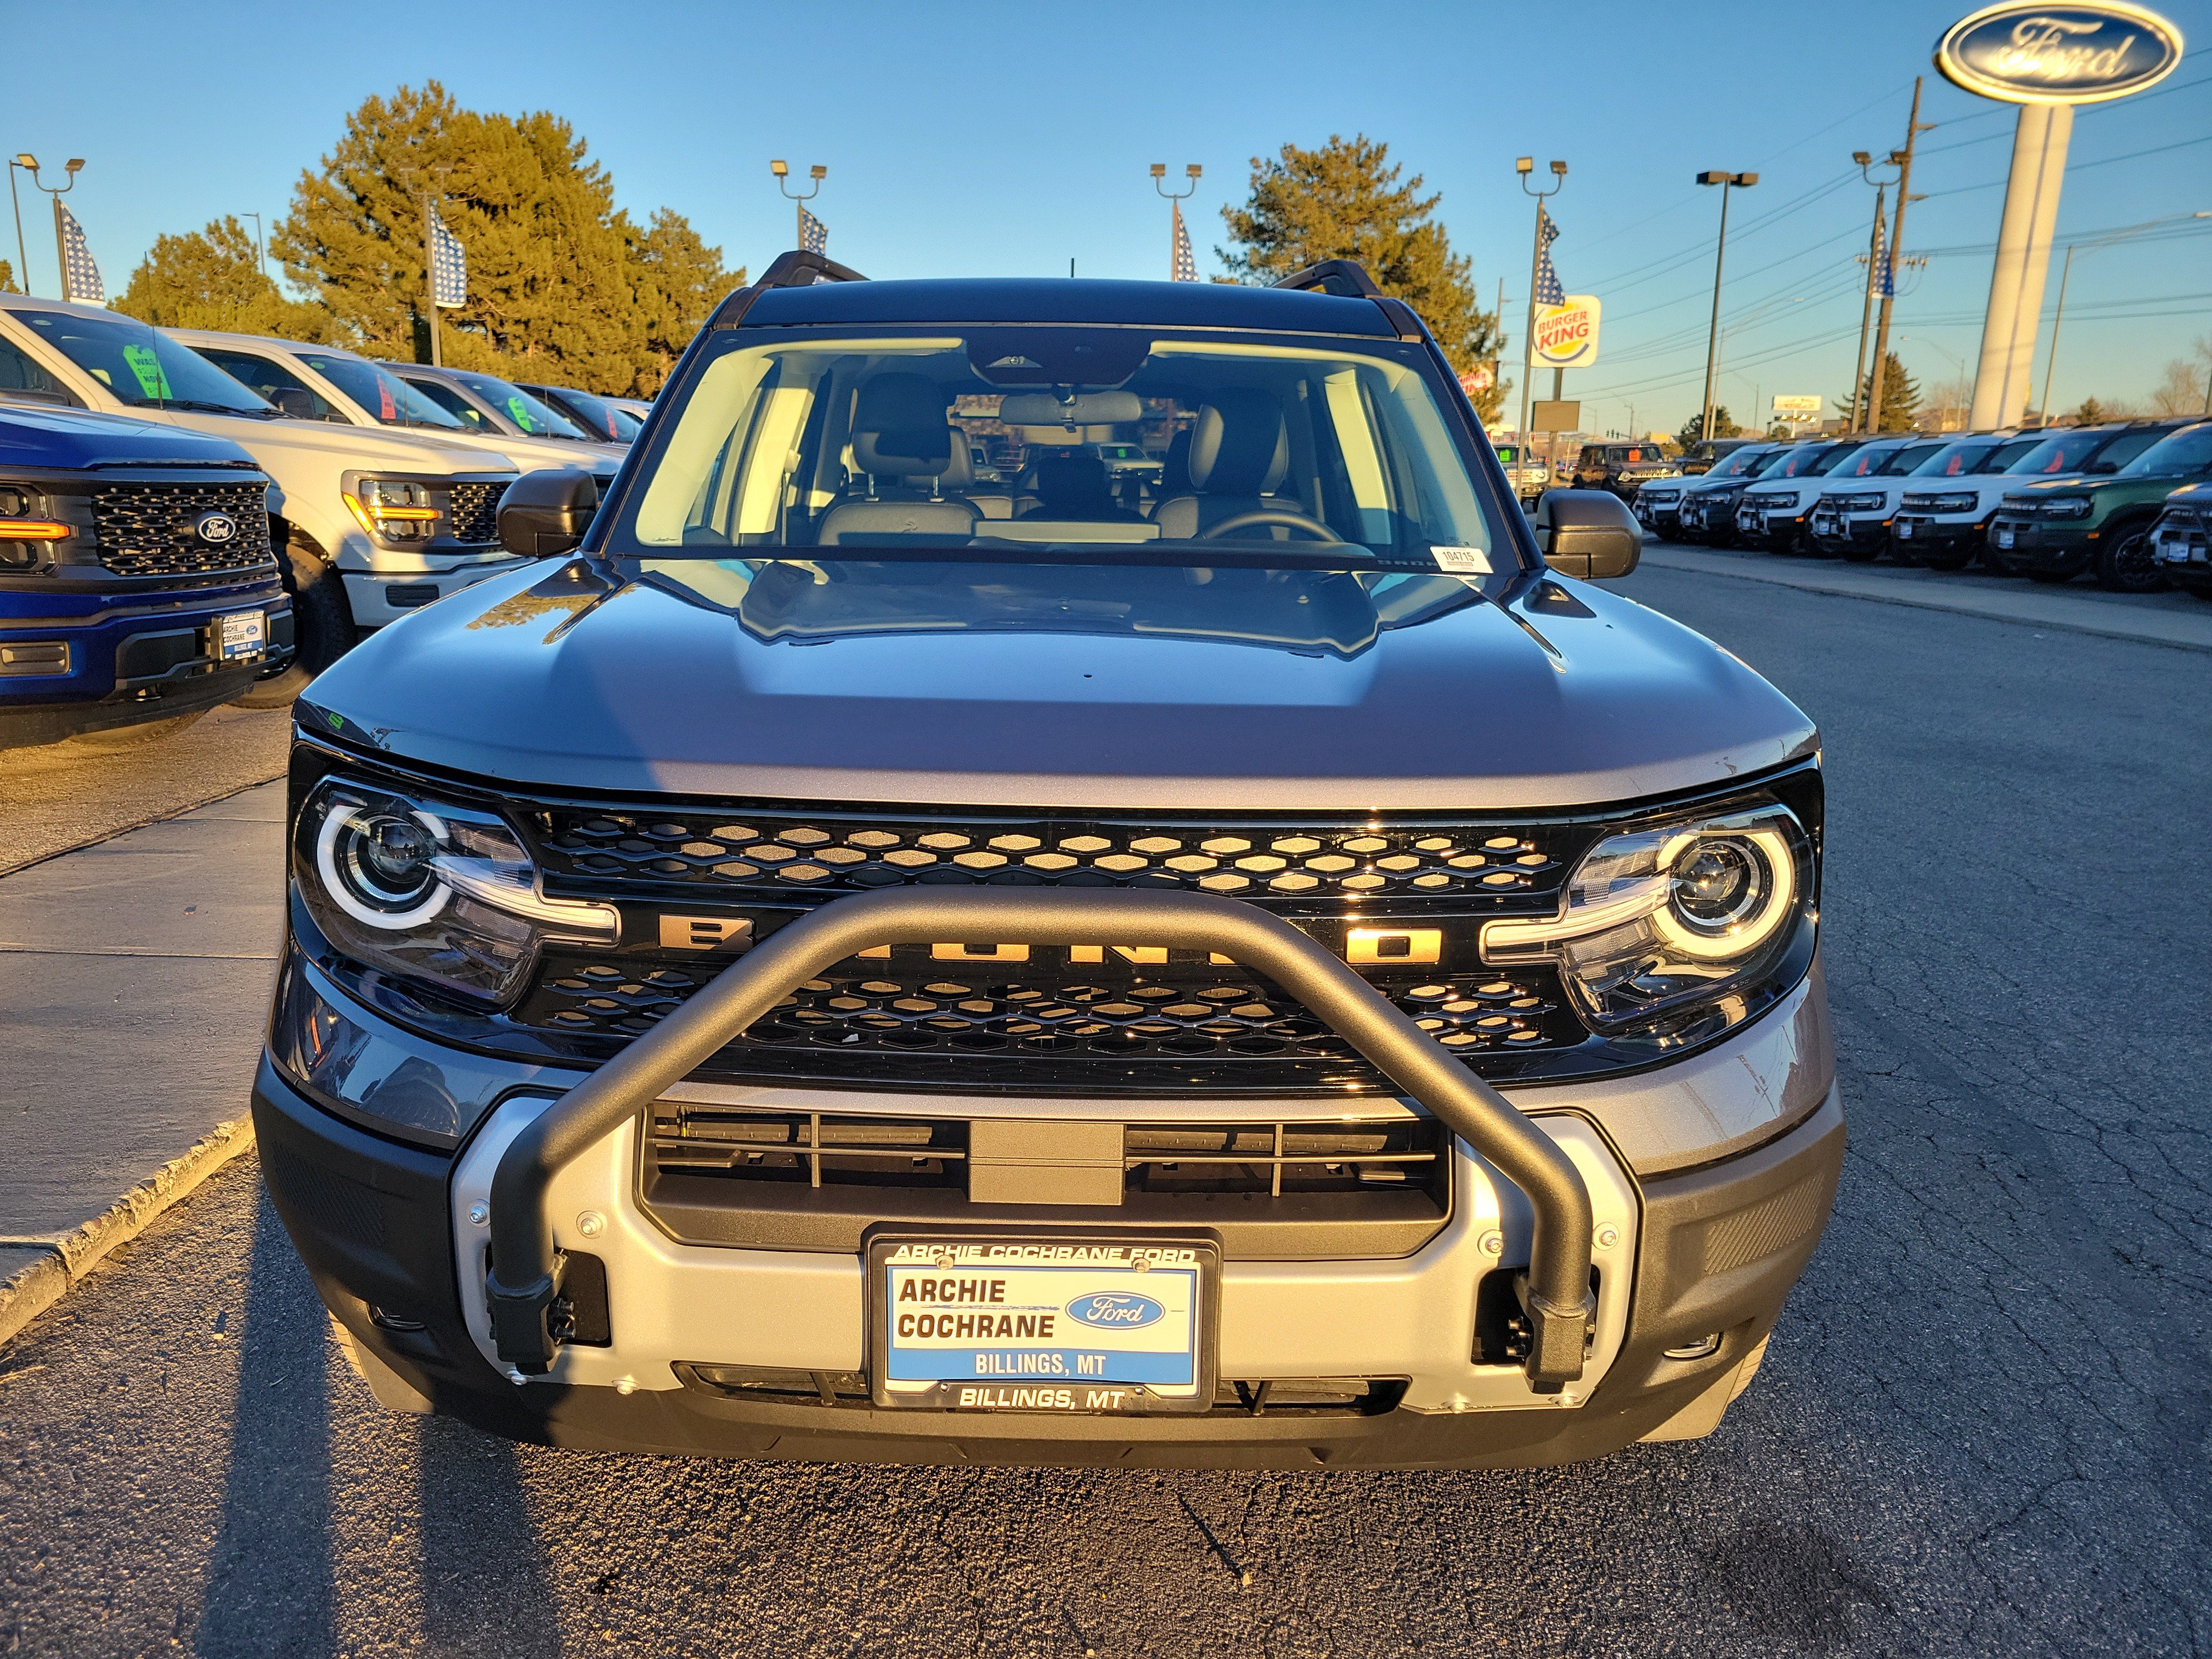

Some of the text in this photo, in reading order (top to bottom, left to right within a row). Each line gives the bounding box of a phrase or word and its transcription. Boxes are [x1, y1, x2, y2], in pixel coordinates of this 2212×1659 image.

[1991, 16, 2136, 78] Ford
[1538, 311, 1587, 333] BURGER
[1539, 322, 1589, 351] KING
[206, 520, 229, 538] Ford
[1442, 552, 1474, 561] 104715
[223, 634, 245, 642] COCHRANE
[893, 1244, 1197, 1263] ARCHIE COCHRANE FORD
[899, 1279, 1006, 1303] ARCHIE
[1086, 1296, 1144, 1323] Ford
[898, 1314, 1055, 1338] COCHRANE
[975, 1353, 1107, 1376] BILLINGS, MT
[958, 1388, 1125, 1410] BILLINGS, MT
